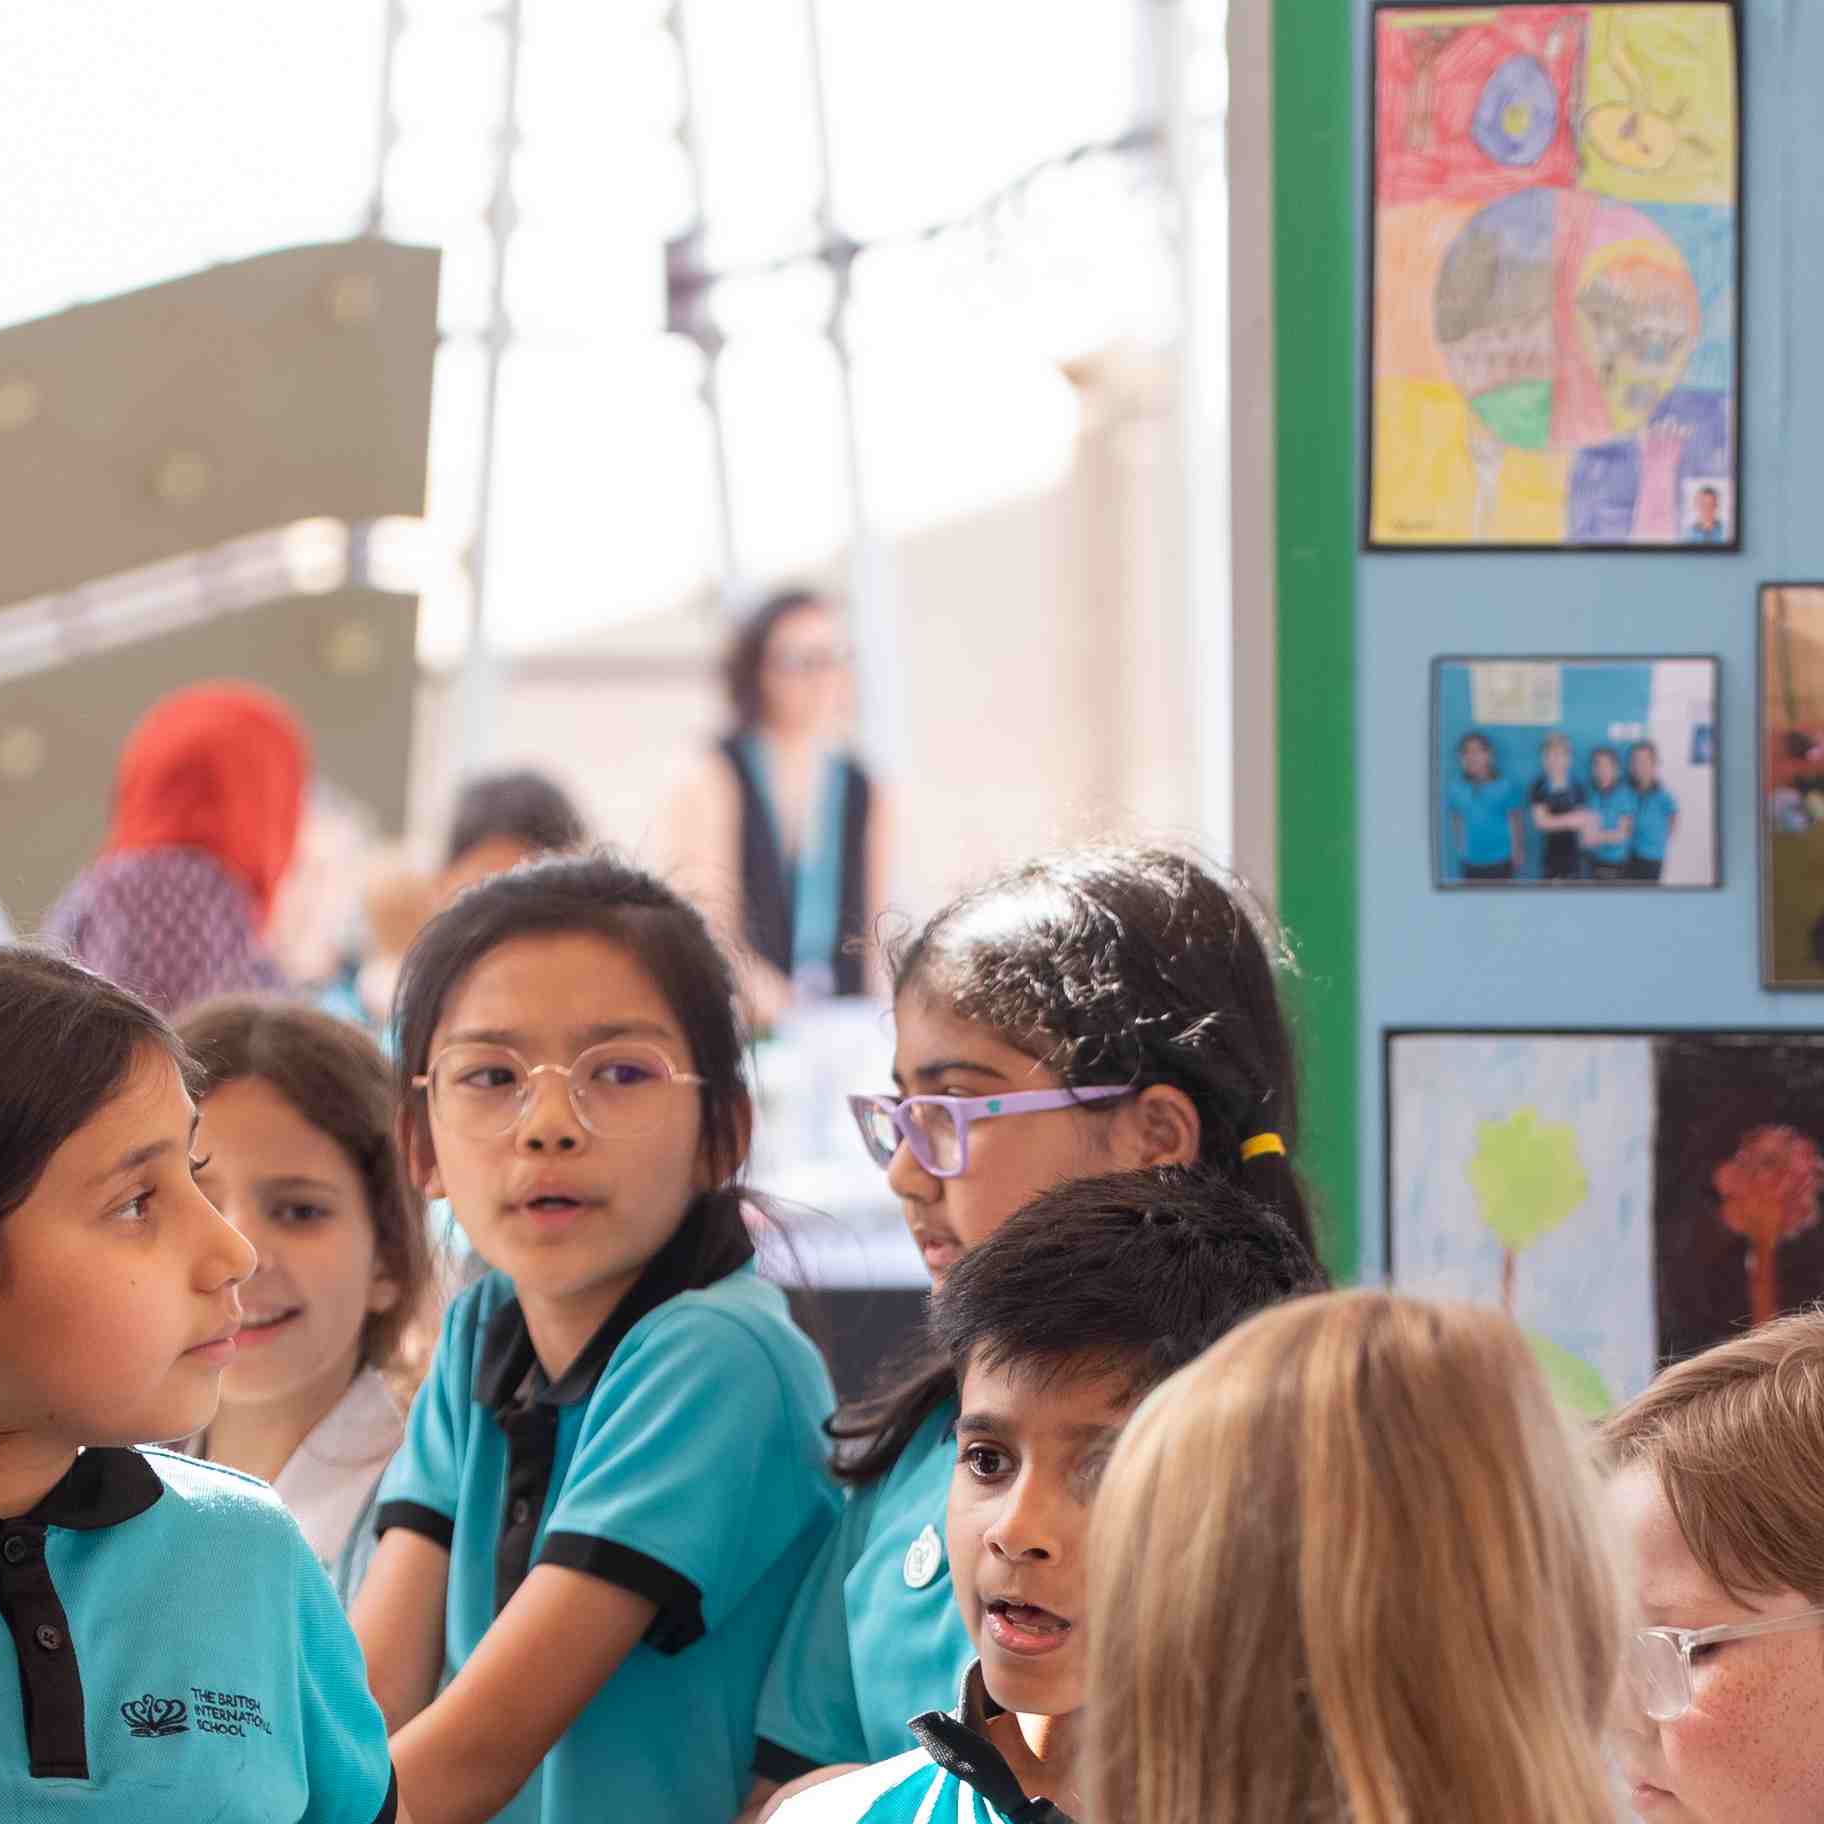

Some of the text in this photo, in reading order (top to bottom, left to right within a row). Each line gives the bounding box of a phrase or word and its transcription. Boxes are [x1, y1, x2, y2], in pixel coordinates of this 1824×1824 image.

[191, 1688, 261, 1713] THE BRITISH
[196, 1719, 247, 1738] SCHOOL
